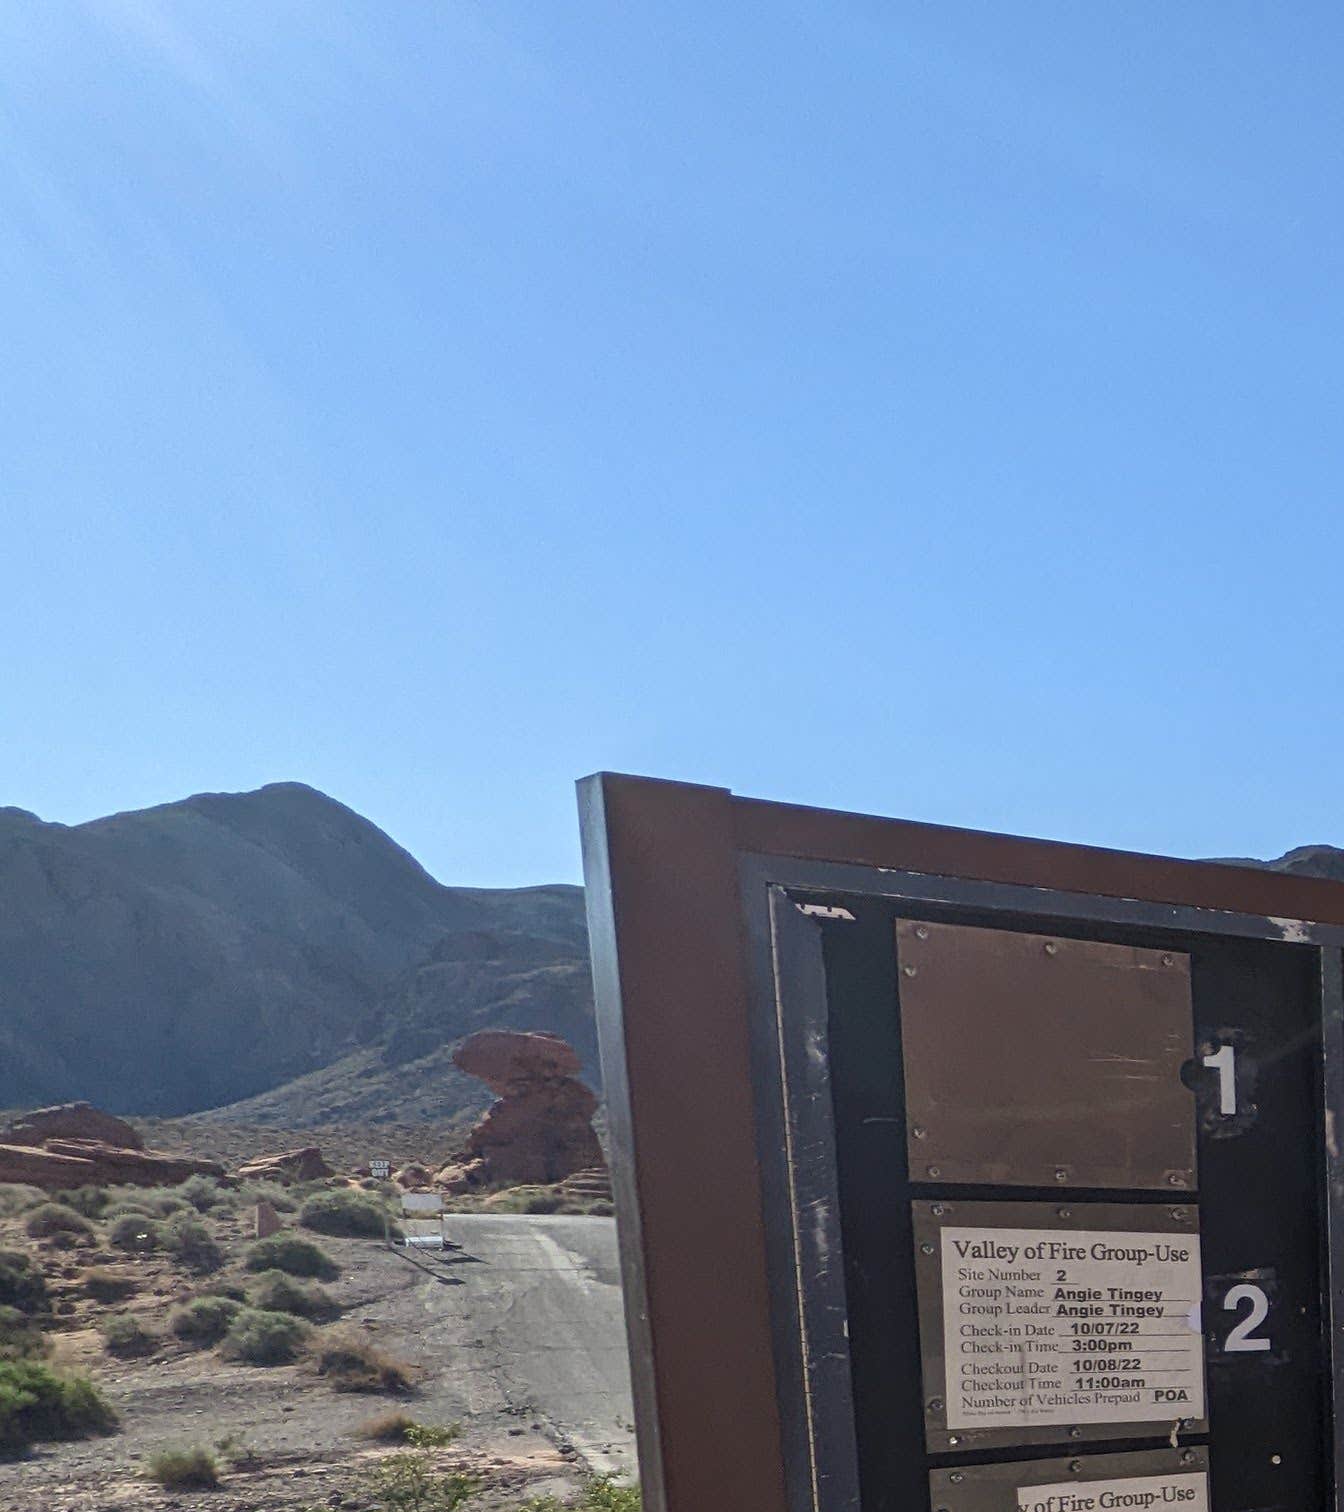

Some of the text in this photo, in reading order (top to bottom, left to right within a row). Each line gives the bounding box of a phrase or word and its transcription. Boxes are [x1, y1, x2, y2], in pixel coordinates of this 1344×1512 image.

[1203, 1046, 1237, 1115] 1
[953, 1241, 1189, 1265] Valley of Fire Group-Use
[958, 1268, 1067, 1282] Site Number 2
[959, 1285, 1163, 1302] Group Name Angie Tingey
[959, 1302, 1165, 1319] Group Leader Angie Tingey
[1223, 1284, 1271, 1352] 2
[960, 1322, 1140, 1337] Check-in Date 10/07/22
[960, 1339, 1133, 1354] Check-in Time 3:00pm
[960, 1358, 1142, 1376] Checkout Date 10/08/22
[961, 1377, 1146, 1392] Checkout Time 11:00am
[961, 1389, 1189, 1409] Number of Vehicles Prepaid POA
[1058, 1494, 1096, 1512] Fire
[1100, 1486, 1196, 1510] Group-Use
